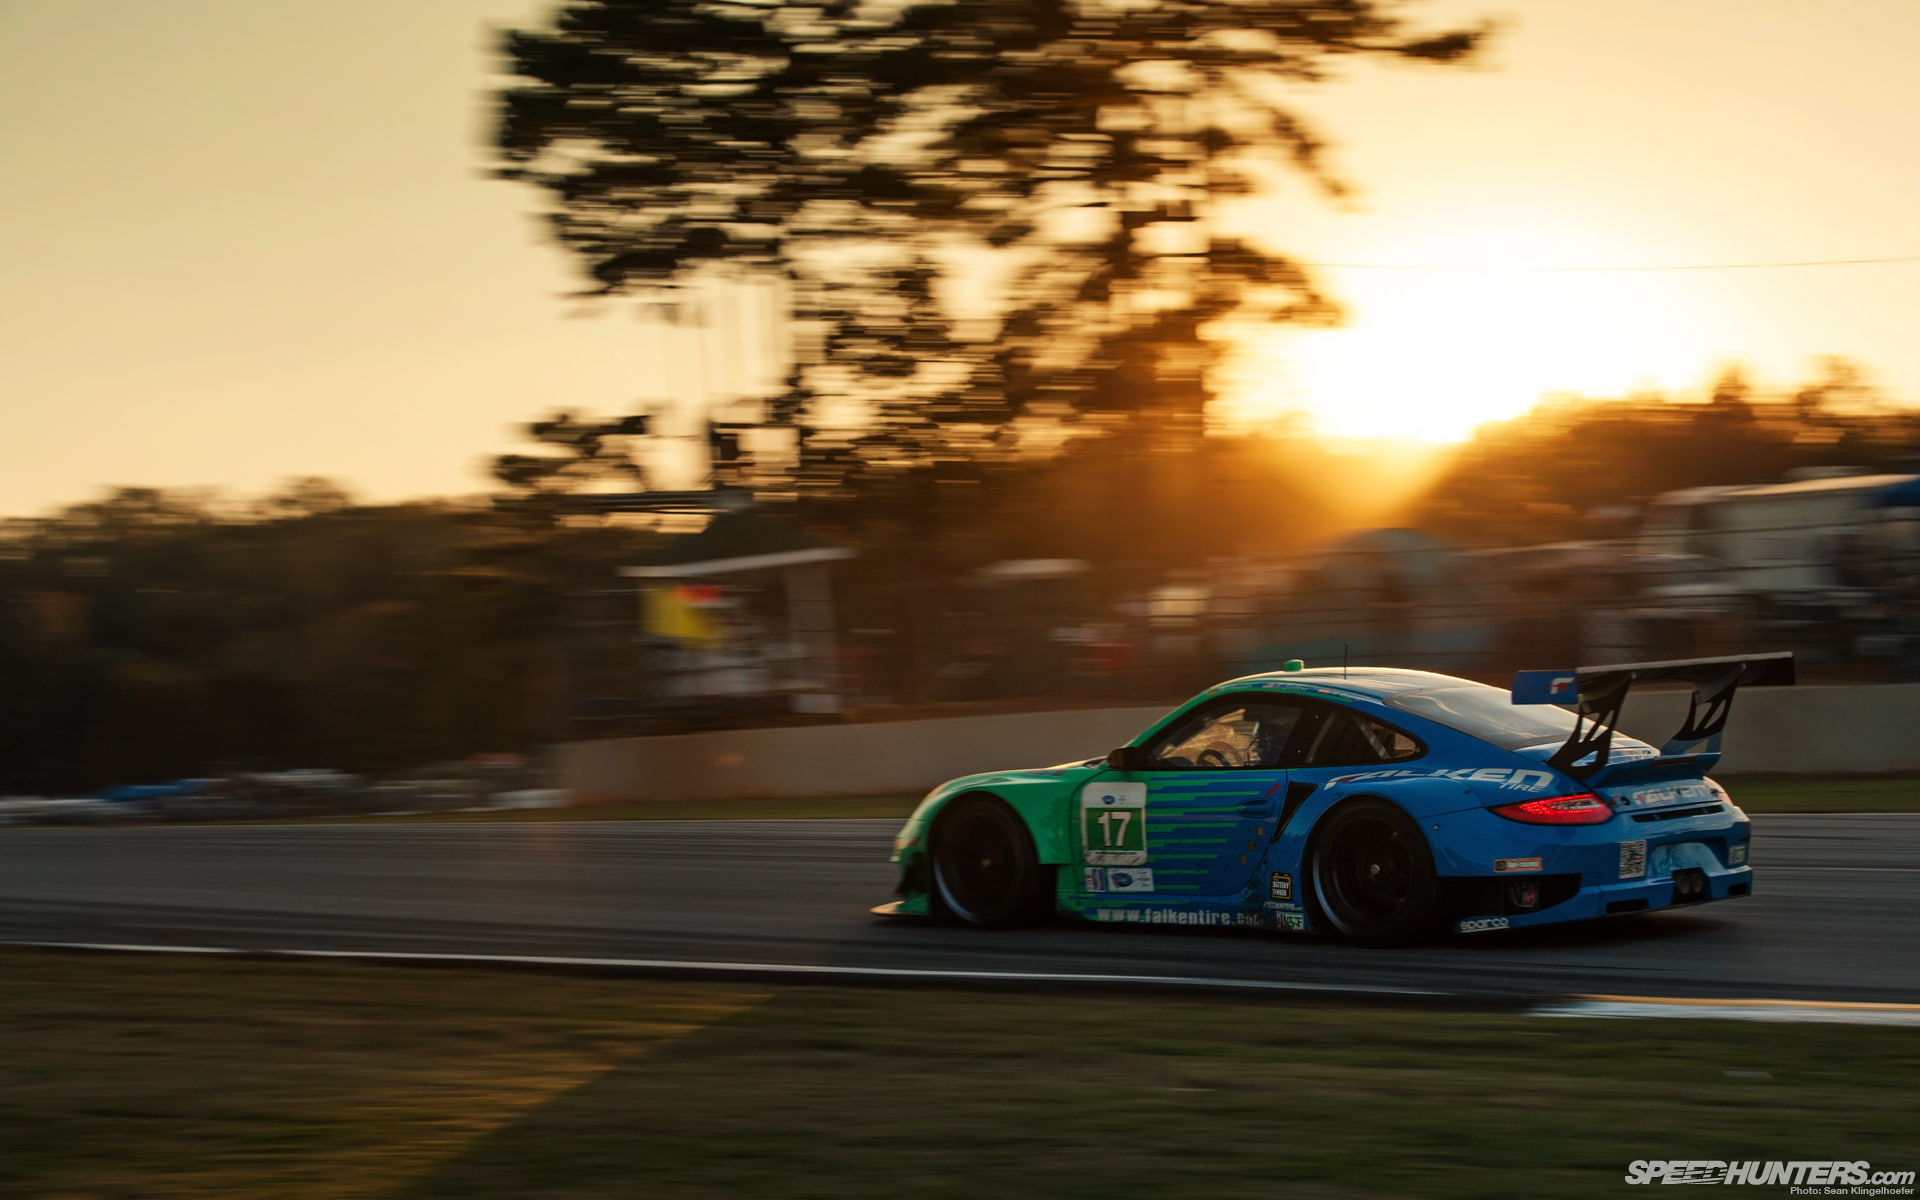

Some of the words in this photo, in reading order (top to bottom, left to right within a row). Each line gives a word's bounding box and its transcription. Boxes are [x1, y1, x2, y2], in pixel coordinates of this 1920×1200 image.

[1323, 768, 1555, 791] FALKEN
[1499, 781, 1542, 793] TIRE
[1096, 810, 1133, 848] 17
[1461, 917, 1509, 932] sparco
